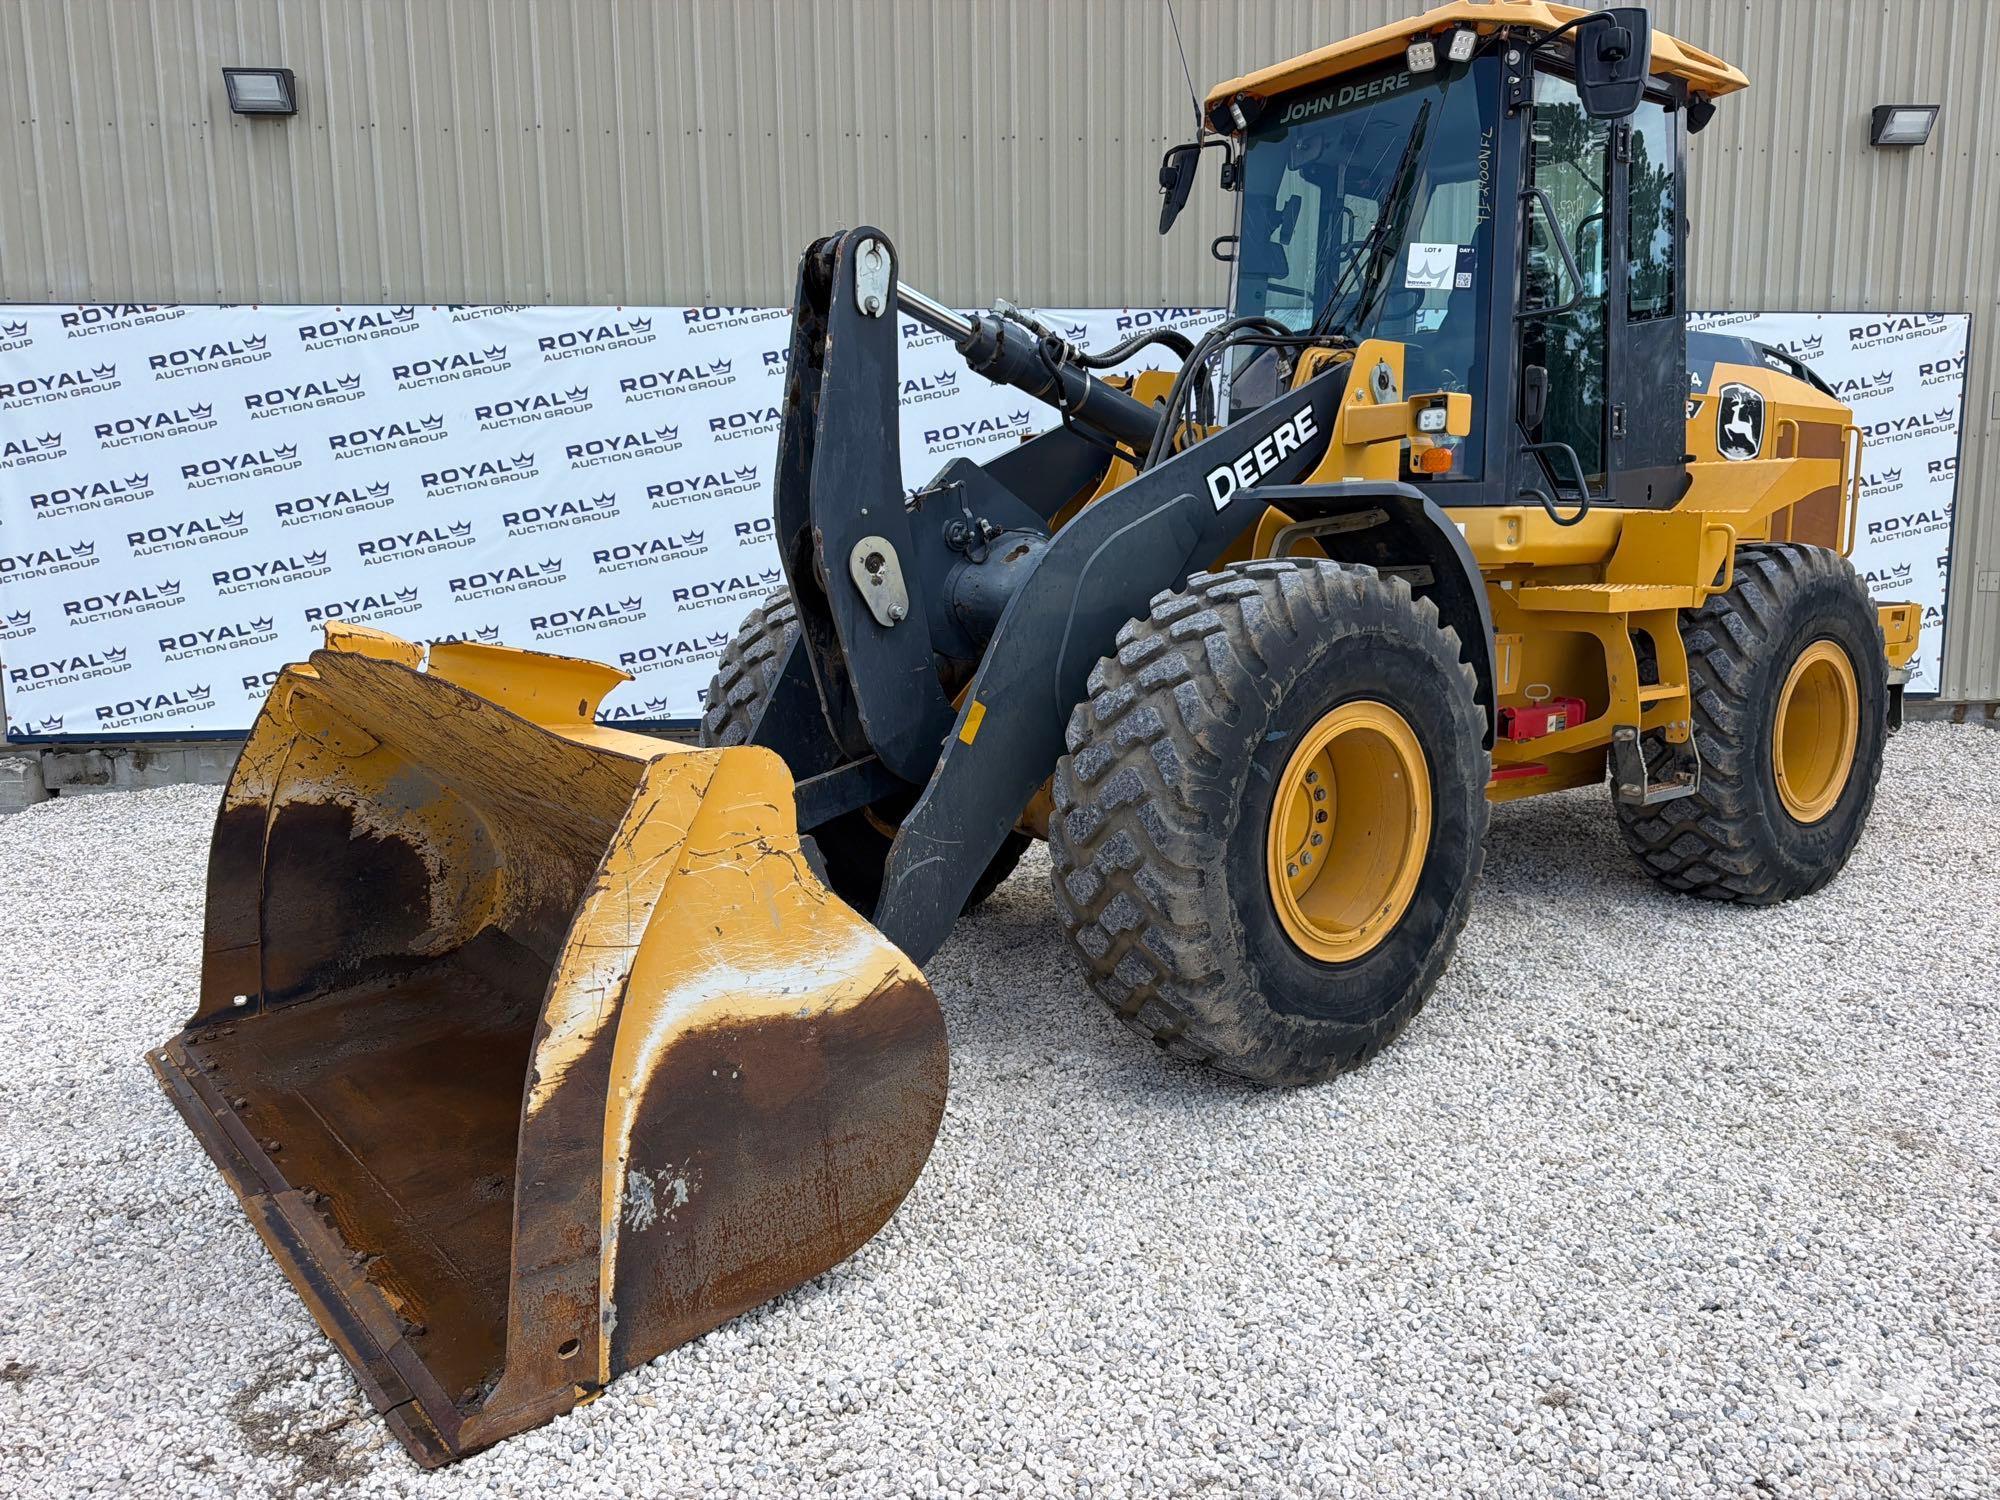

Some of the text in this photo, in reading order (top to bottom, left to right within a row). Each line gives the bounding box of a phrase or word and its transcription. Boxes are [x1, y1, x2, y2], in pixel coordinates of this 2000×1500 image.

[1280, 72, 1411, 124] JOHN DEERE
[68, 310, 185, 339] AUCTION GROUP
[299, 313, 392, 341] ROYAL
[451, 306, 514, 323] AUCTION
[688, 317, 748, 335] AUCTION
[1181, 314, 1225, 329] GROUP
[305, 323, 419, 352] AUCTION GROUP
[538, 324, 630, 352] ROYAL
[907, 335, 953, 349] AUCTI
[1849, 316, 1926, 341] ROYAL
[1851, 326, 1947, 351] AUCTION GROUP
[0, 339, 33, 352] OUP
[149, 342, 244, 370] ROYAL
[544, 335, 656, 362] AUCTION GROUP
[156, 352, 272, 381] AUCTION GROUP
[392, 352, 484, 380] ROYAL
[398, 362, 511, 391] AUCTION GROUP
[620, 366, 710, 392] ROYAL
[0, 371, 93, 399] ROYAL
[3, 381, 121, 410] AUCTION GROUP
[245, 381, 338, 409] ROYAL
[626, 376, 736, 403] AUCTION GROUP
[914, 388, 960, 402] GROUP
[1829, 377, 1872, 394] YAL
[1853, 387, 1894, 401] GROUP
[251, 391, 365, 420] AUCTION GROUP
[475, 393, 566, 420] ROYAL
[481, 403, 592, 431] AUCTION GROUP
[94, 410, 190, 438] ROYAL
[709, 408, 781, 433] ROYA
[714, 425, 773, 442] AUCTION
[925, 417, 1008, 444] ROYAL
[1915, 423, 1955, 437] GROUP
[101, 420, 217, 449] AUCTION GROUP
[329, 422, 421, 450] ROYAL
[335, 432, 448, 460] AUCTION GROUP
[566, 432, 656, 459] ROYAL
[928, 435, 985, 454] AUCTION
[16, 450, 67, 465] GROUP
[181, 451, 274, 479] ROYAL
[572, 442, 682, 470] AUCTION GROUP
[1206, 404, 1318, 511] DEERE
[188, 461, 302, 490] AUCTION GROUP
[421, 460, 512, 488] ROYAL
[427, 470, 539, 498] AUCTION GROUP
[646, 472, 735, 499] ROYAL
[30, 480, 126, 509] ROYAL
[275, 489, 367, 517] ROYAL
[652, 482, 761, 509] AUCTION GROUP
[1863, 483, 1903, 497] GROUP
[37, 490, 154, 520] AUCTION GROUP
[282, 498, 394, 527] AUCTION GROUP
[503, 500, 593, 527] ROYAL
[127, 518, 221, 546] ROYAL
[508, 510, 620, 537] AUCTION GROUP
[1868, 510, 1943, 535] ROYAL
[1870, 528, 1921, 544] AUCTION
[134, 528, 248, 558] AUCTION GROUP
[358, 528, 449, 556] ROYAL
[364, 538, 476, 566] AUCTION GROUP
[593, 537, 682, 564] ROYAL
[738, 534, 776, 549] AUCT
[0, 548, 72, 572] OYAL
[0, 558, 100, 584] CTION GROUP
[212, 558, 304, 586] ROYAL
[599, 547, 708, 574] AUCTION GROUP
[218, 567, 331, 596] AUCTION GROUP
[449, 565, 540, 592] ROYAL
[455, 575, 566, 602] AUCTION GROUP
[673, 575, 760, 602] ROYAL
[1872, 578, 1913, 592] GROUP
[63, 587, 158, 616] ROYAL
[70, 597, 185, 626] AUCTION GROUP
[305, 594, 396, 622] ROYAL
[374, 604, 422, 619] GROUP
[678, 585, 781, 612] AUCTION GROU
[530, 603, 620, 630] ROYAL
[536, 612, 646, 640] AUCTION GROUP
[0, 627, 36, 640] ROUP
[158, 624, 251, 652] ROYAL
[165, 633, 278, 662] AUCTION GROUP
[620, 639, 707, 666] ROYAL
[687, 649, 724, 663] GROU
[10, 654, 104, 683] ROYAL
[16, 663, 132, 693] AUCTION GROUP
[96, 692, 188, 720] ROYAL
[102, 701, 215, 730] AUCTION GROUP
[596, 704, 645, 721] YAL
